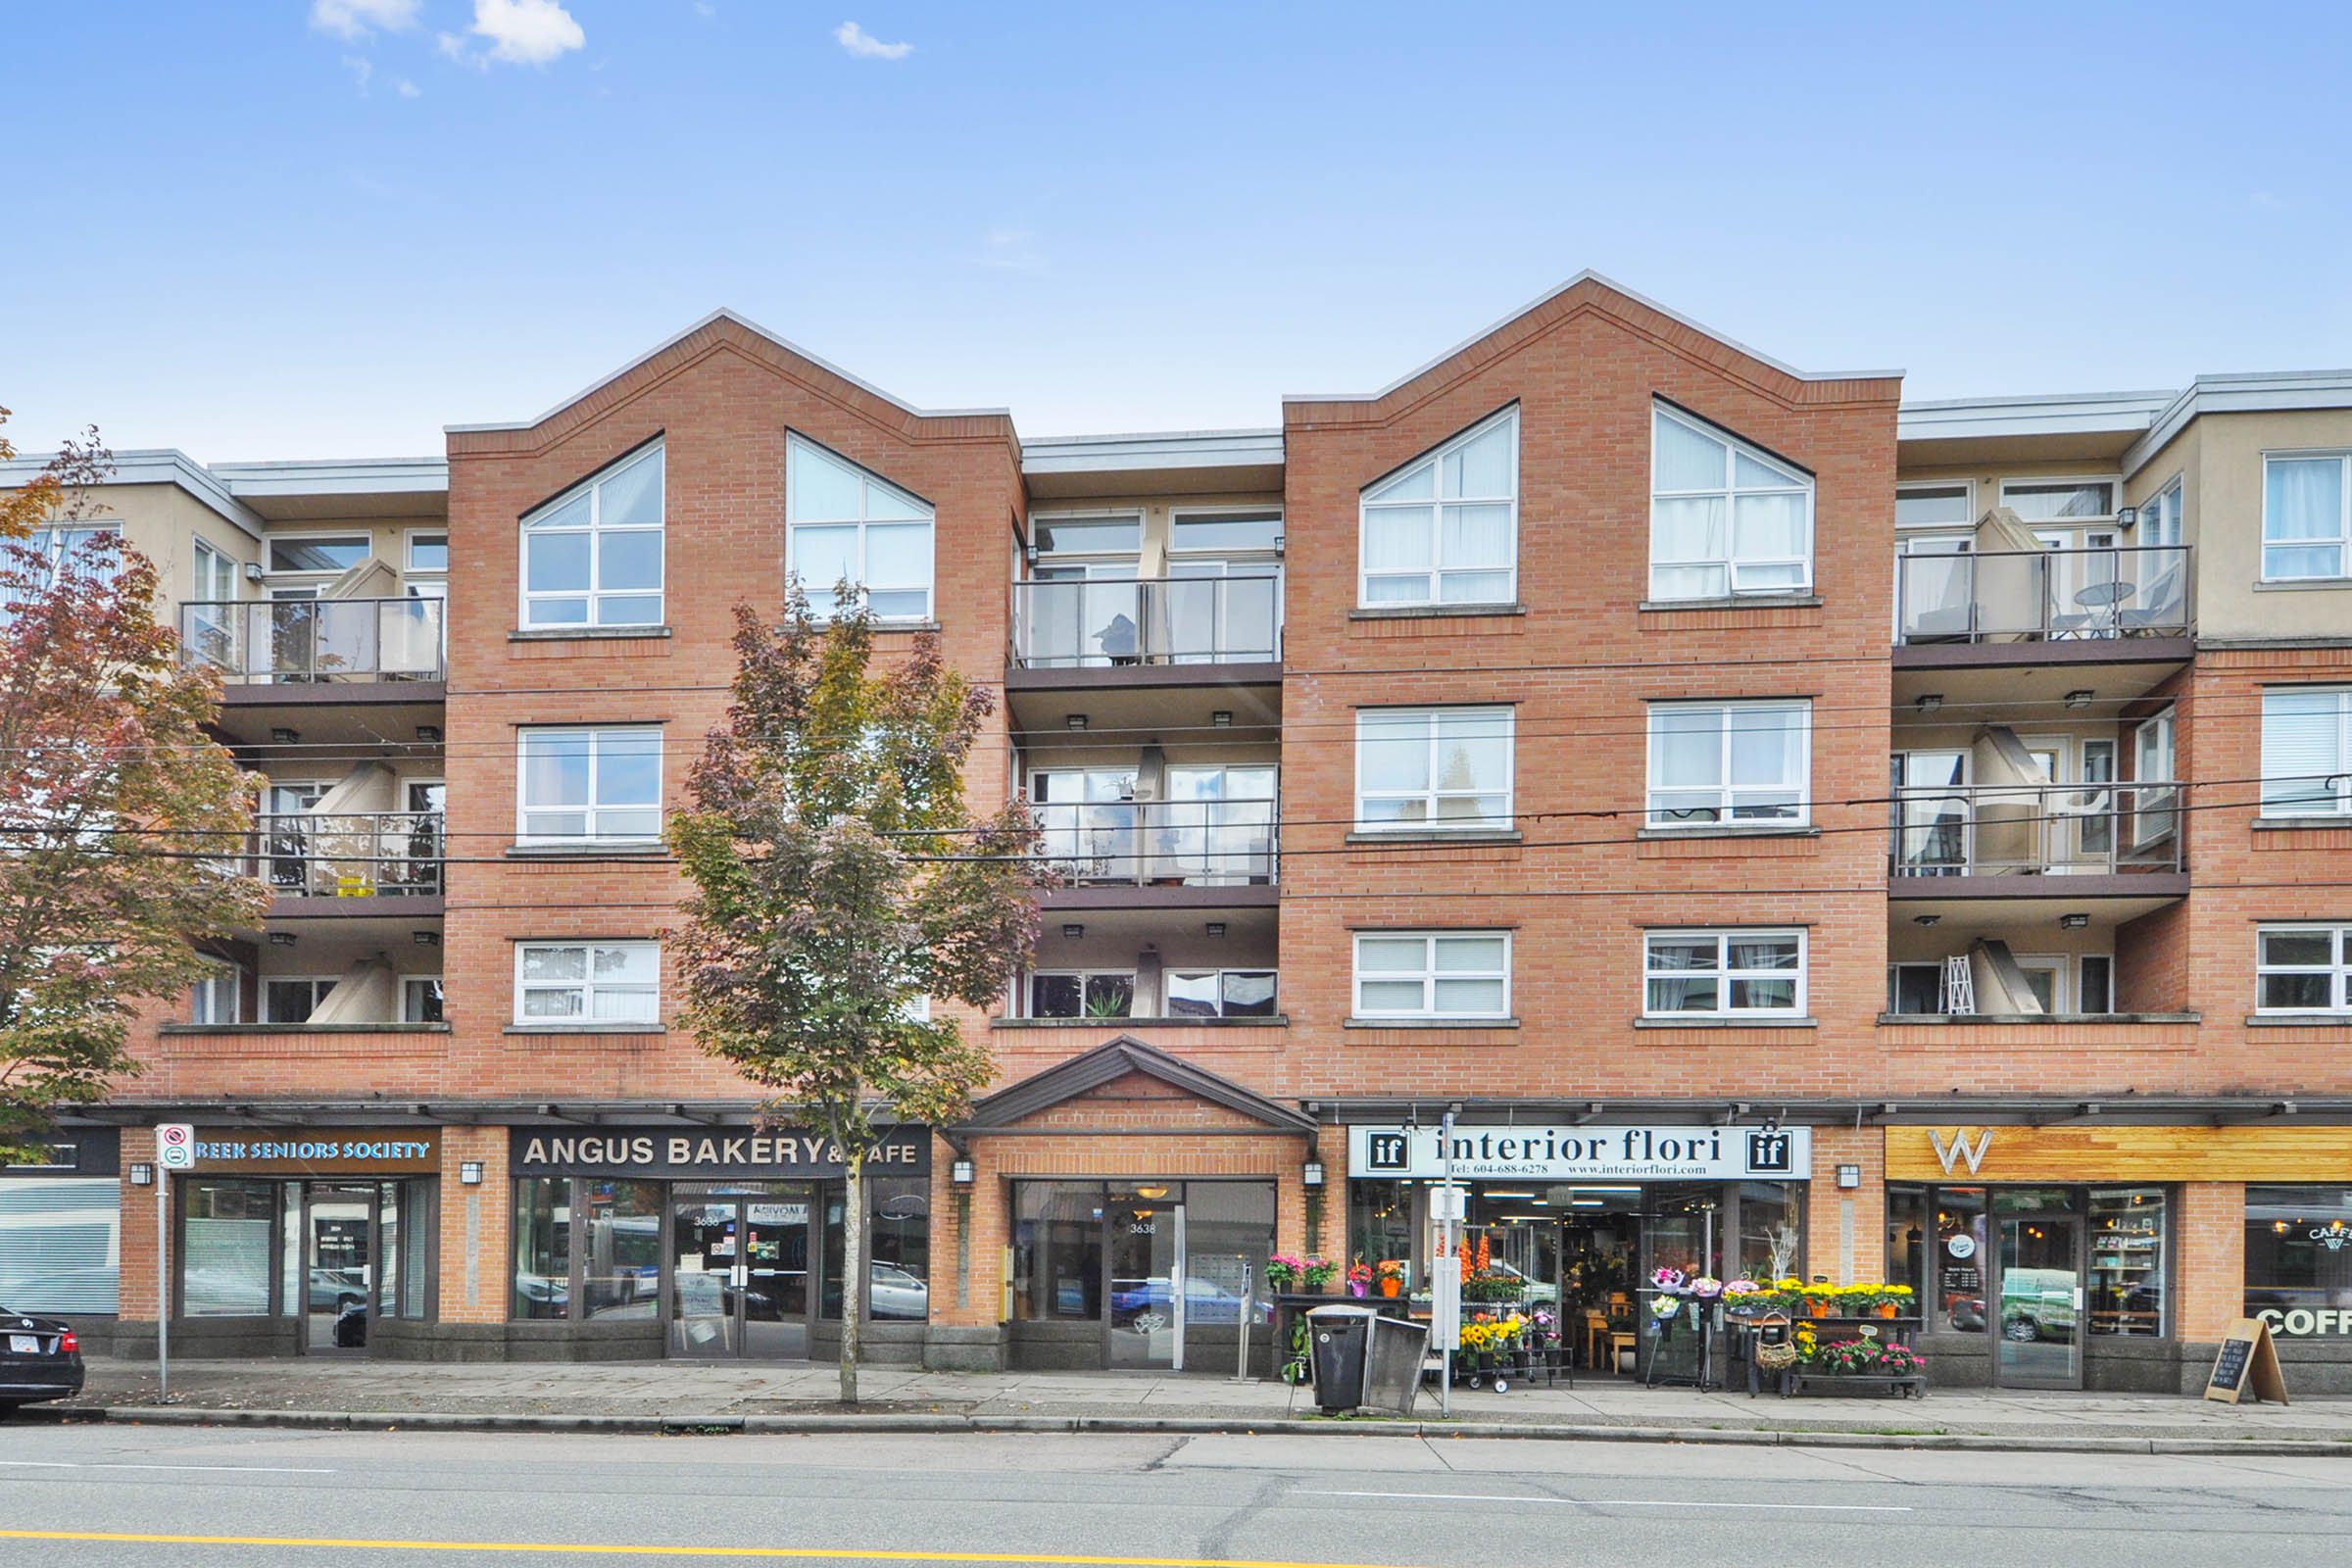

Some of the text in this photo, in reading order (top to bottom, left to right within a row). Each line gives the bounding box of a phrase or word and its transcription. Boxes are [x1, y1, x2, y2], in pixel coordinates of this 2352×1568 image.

[196, 1142, 430, 1159] REEK SENIORS SOCIETY
[523, 1137, 917, 1164] ANGUS BAKERY & AFE
[1375, 1139, 1402, 1164] if
[1435, 1129, 1722, 1161] interior flori
[1756, 1139, 1784, 1165] if
[1928, 1129, 1993, 1176] W
[1473, 1164, 1548, 1174] 604-688-6278
[1568, 1163, 1706, 1175] www.interiorflori.com
[694, 1216, 719, 1227] 3636
[1130, 1223, 1156, 1234] 3638
